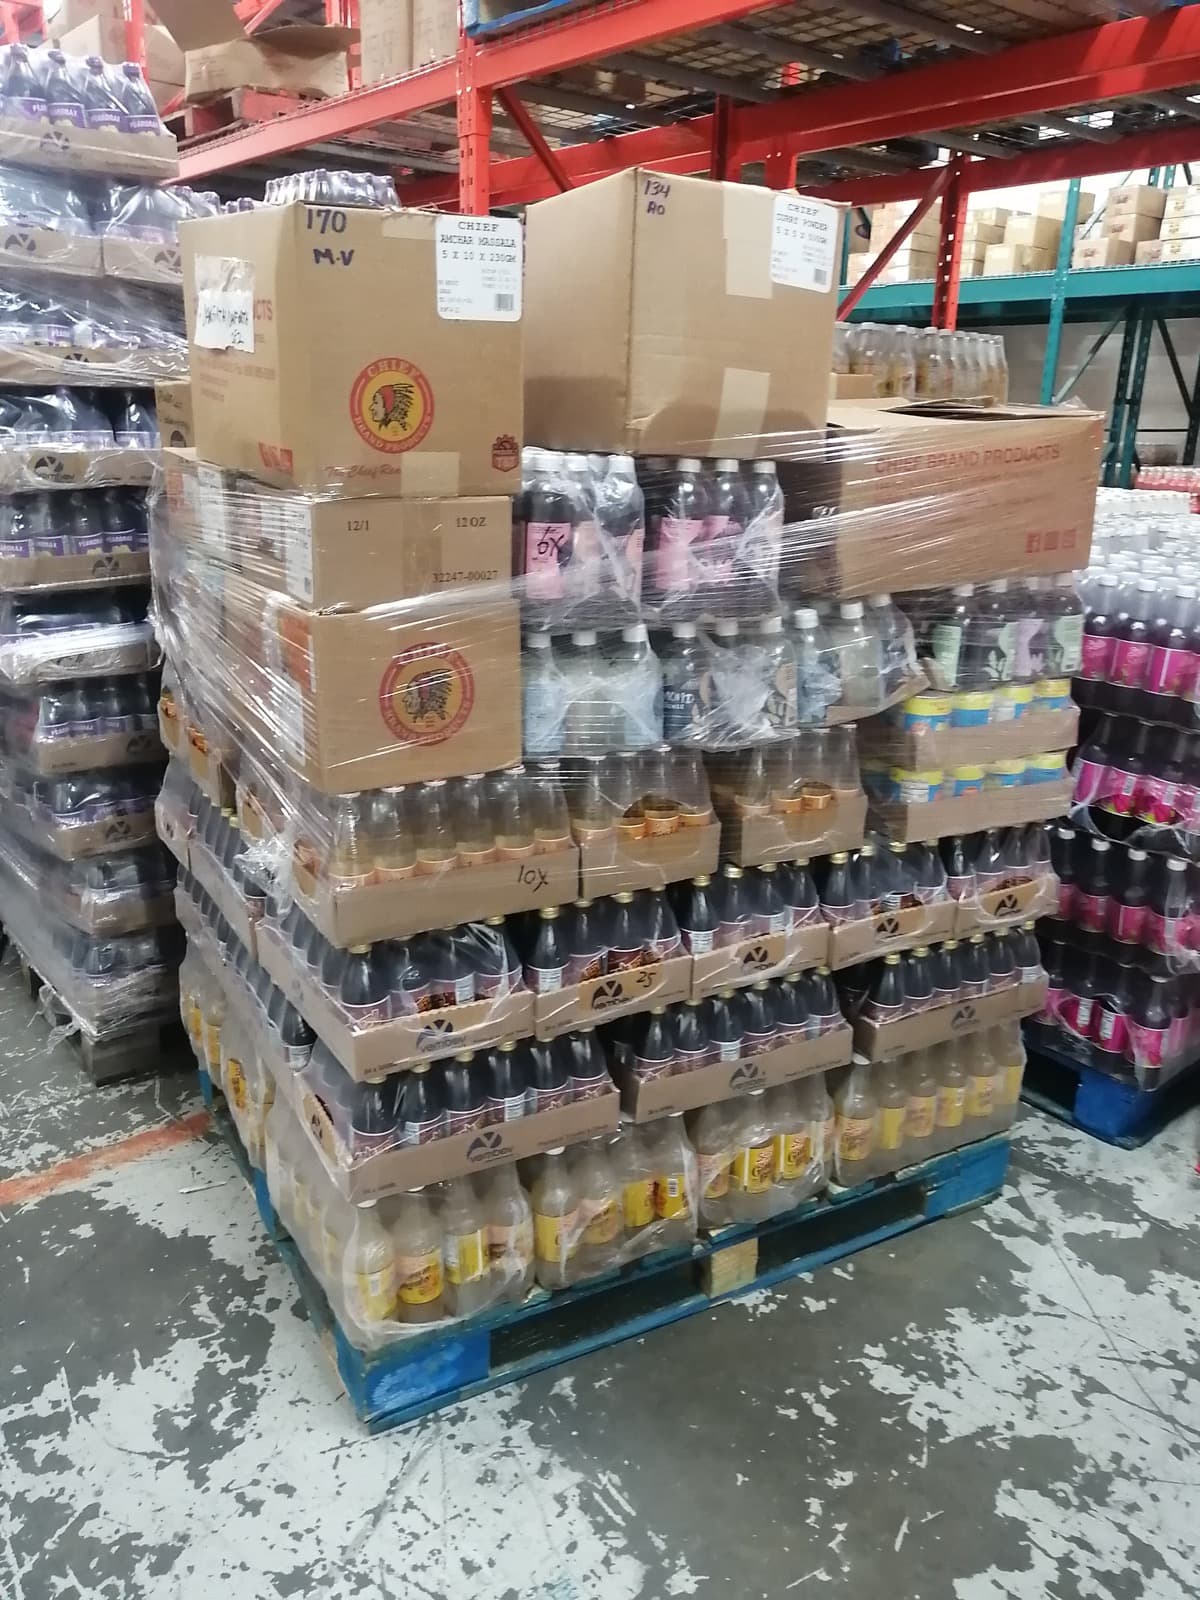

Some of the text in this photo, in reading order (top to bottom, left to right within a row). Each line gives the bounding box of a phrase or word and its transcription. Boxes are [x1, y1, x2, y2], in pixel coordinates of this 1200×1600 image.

[644, 180, 671, 198] 134
[307, 208, 347, 234] 170
[458, 221, 499, 232] CHIEF
[368, 360, 418, 377] CHIEF
[875, 443, 1060, 473] CHIEF BRAND PRODUCTS
[346, 520, 369, 531] 12/1
[636, 971, 656, 987] 25
